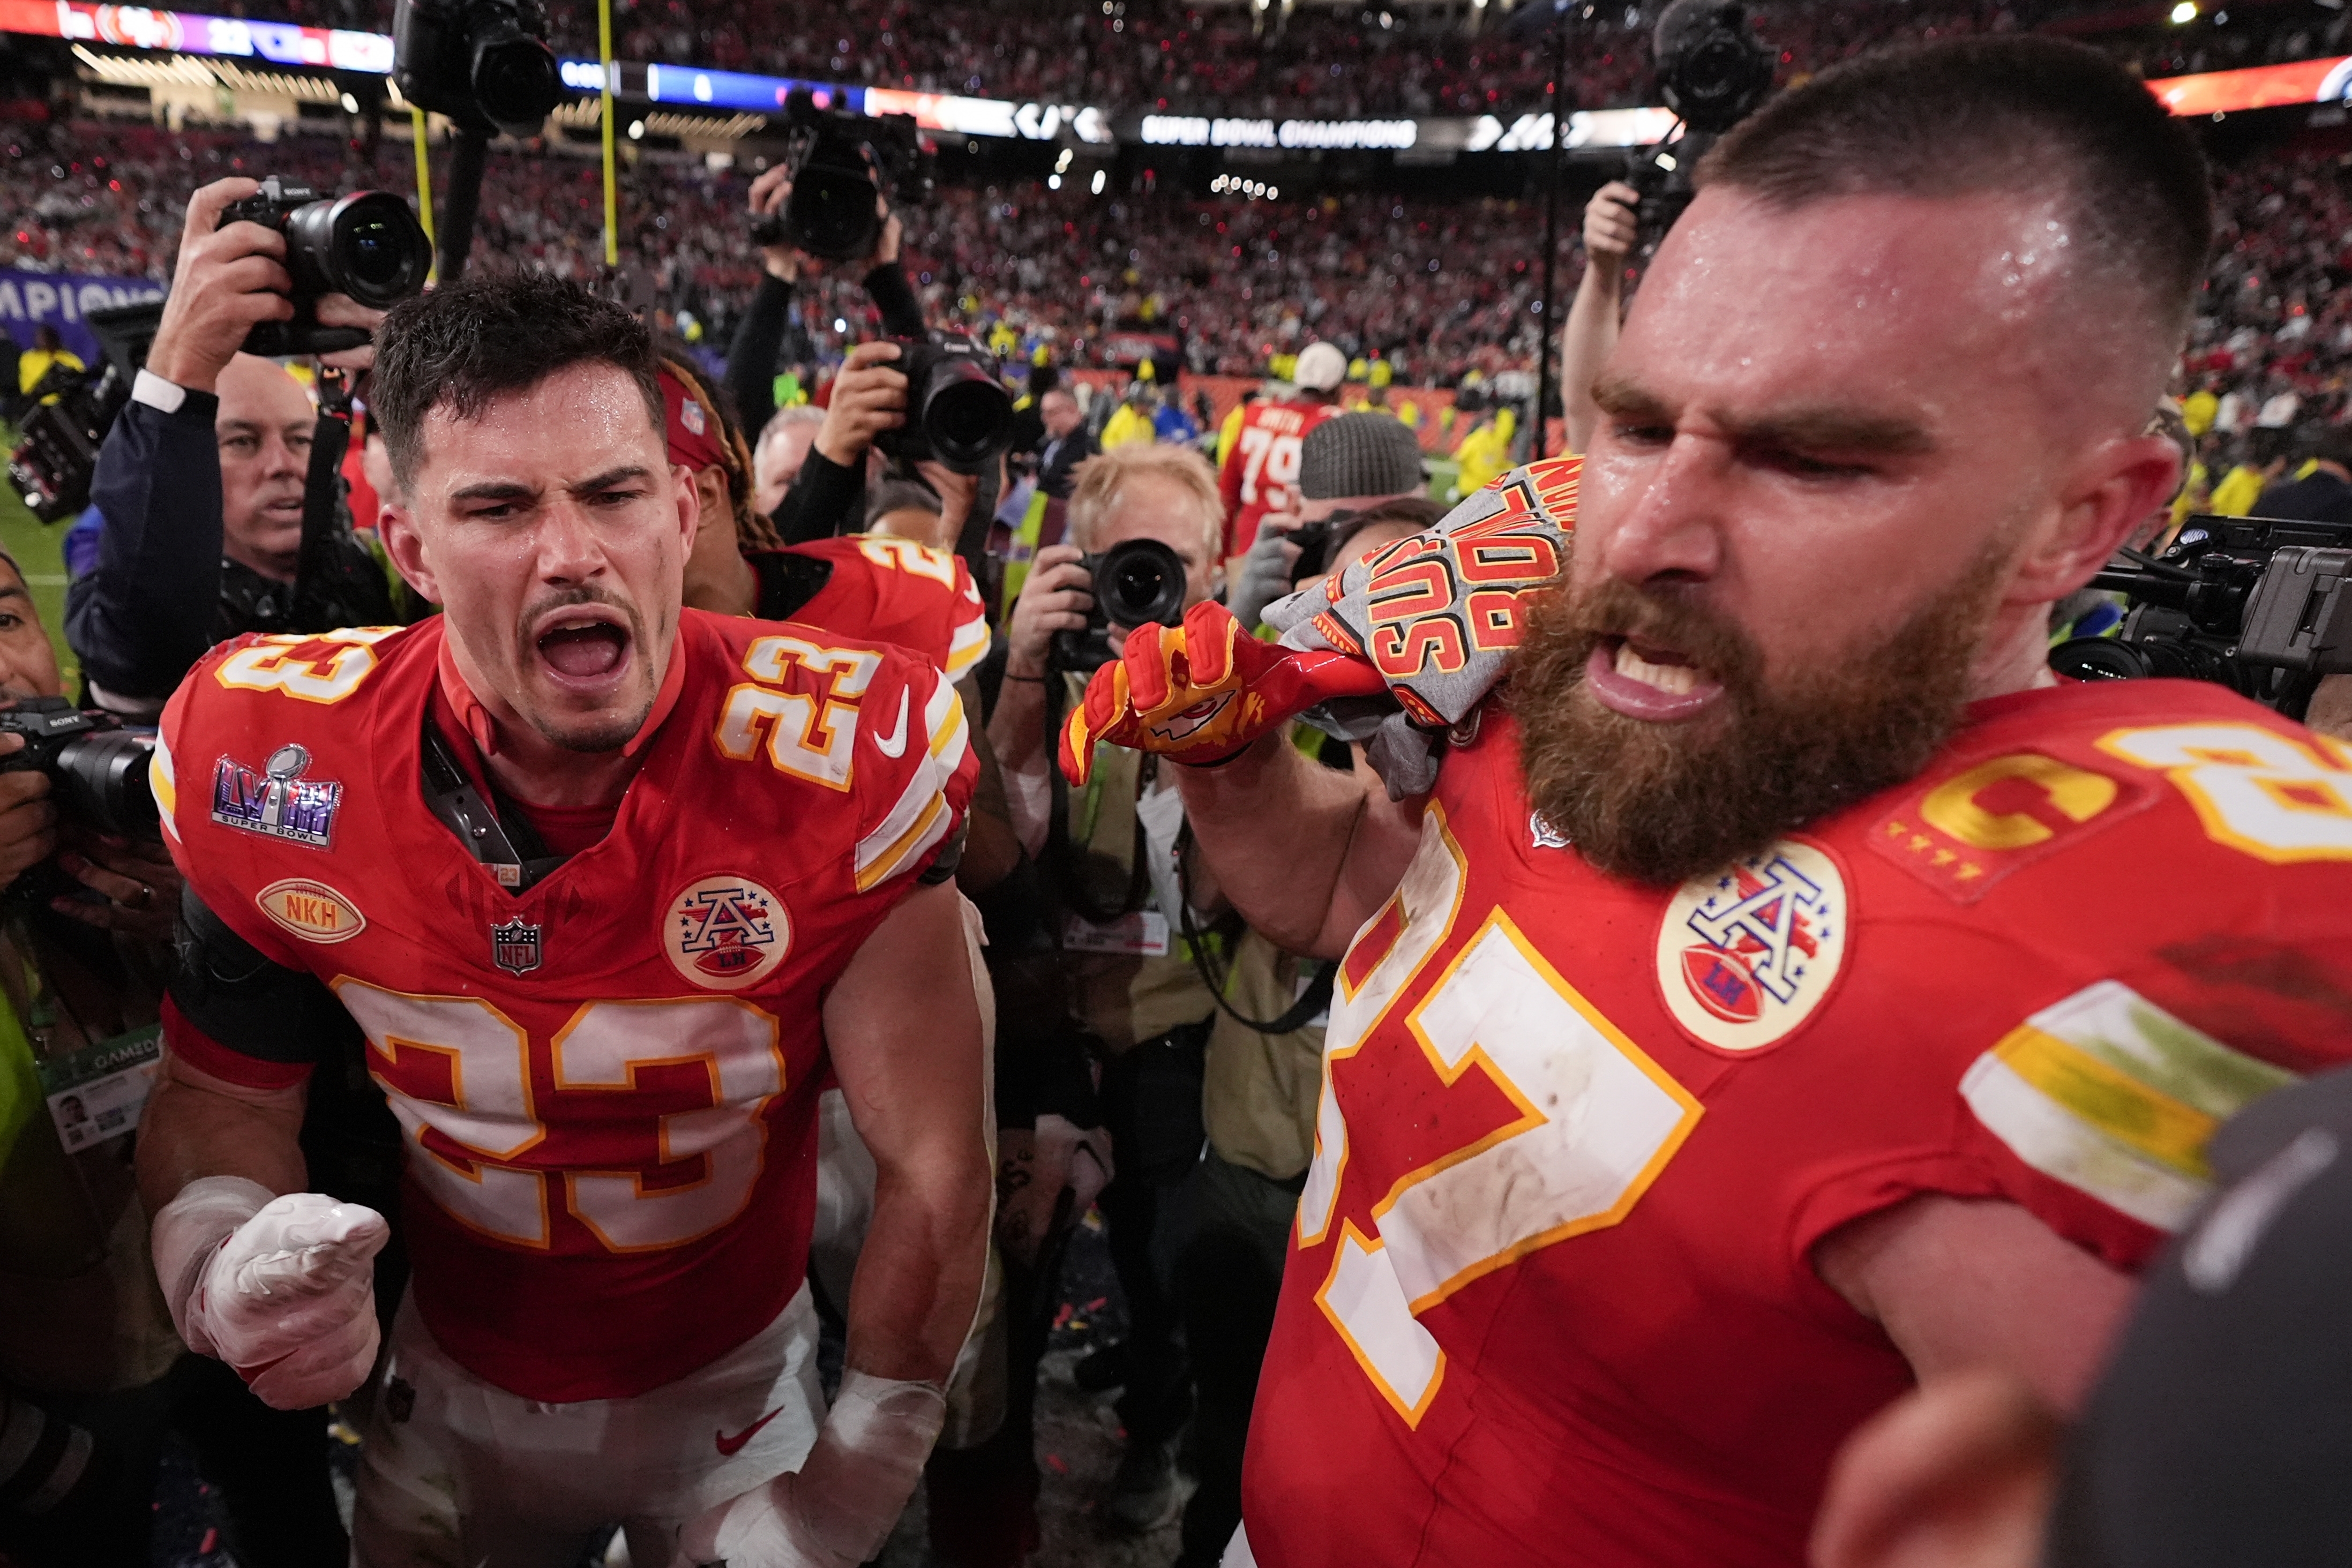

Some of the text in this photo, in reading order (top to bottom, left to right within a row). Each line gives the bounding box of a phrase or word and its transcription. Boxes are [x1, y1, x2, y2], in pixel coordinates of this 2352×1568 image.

[1141, 115, 1418, 149] SUPER BOWL CHAMPIONS
[1239, 425, 1304, 509] 79
[50, 715, 80, 727] SONY
[713, 635, 885, 793] 23
[1918, 752, 2119, 850] C
[221, 815, 317, 842] SUPER BOWL
[286, 894, 336, 929] NKH
[500, 945, 534, 966] NFL
[329, 974, 787, 1253] 23
